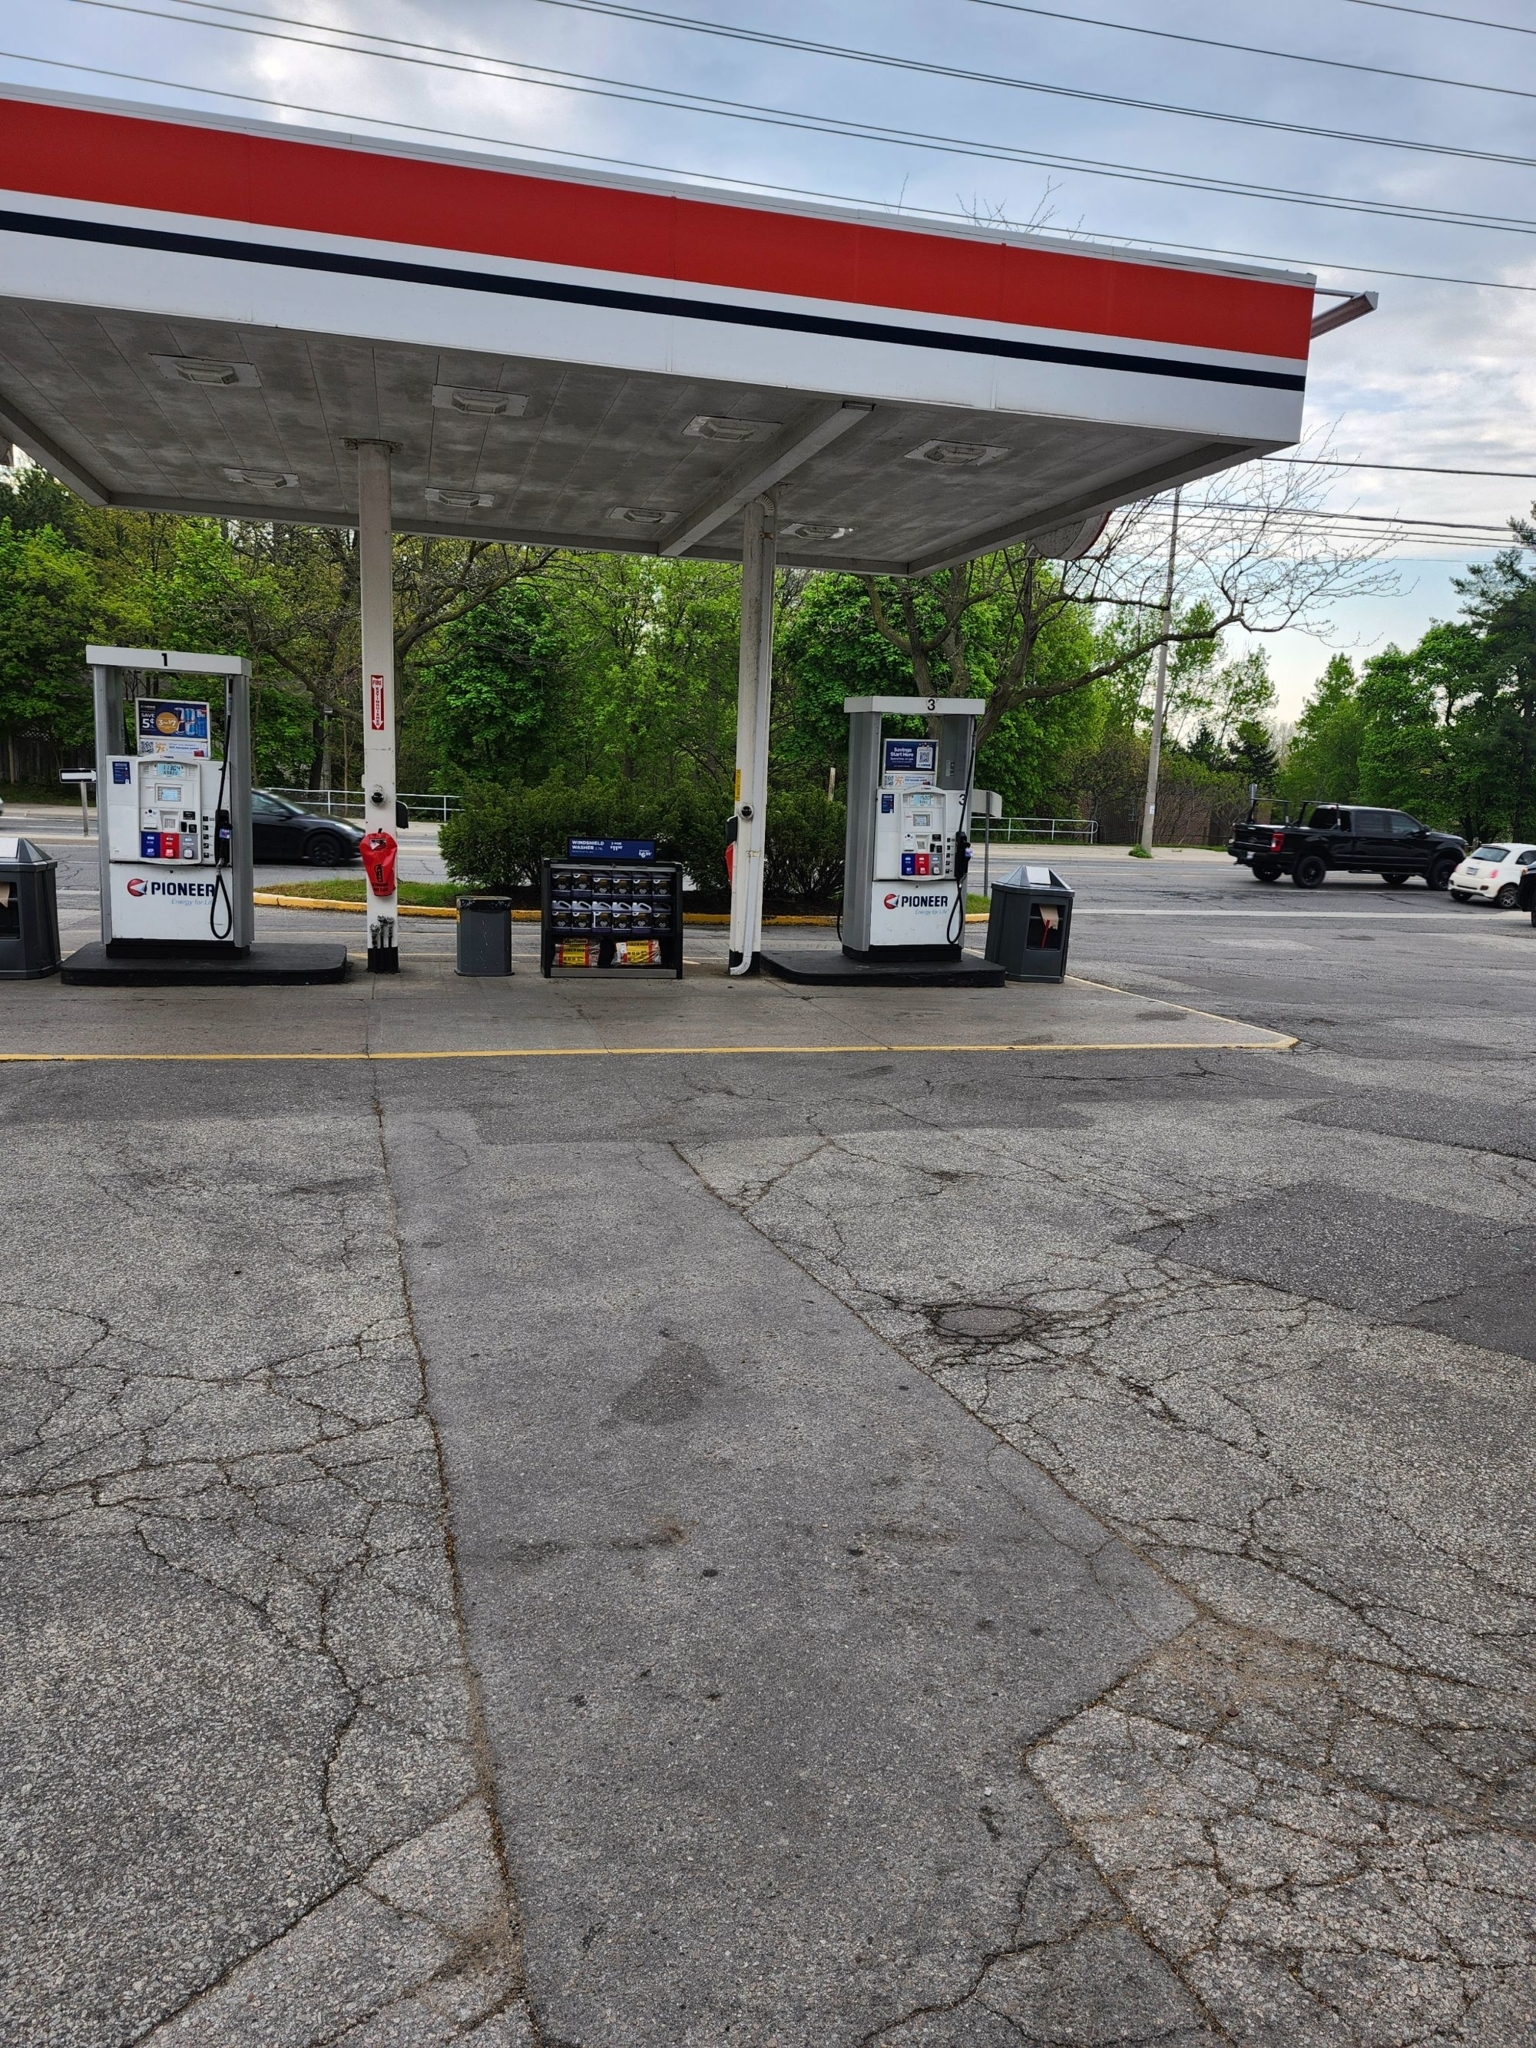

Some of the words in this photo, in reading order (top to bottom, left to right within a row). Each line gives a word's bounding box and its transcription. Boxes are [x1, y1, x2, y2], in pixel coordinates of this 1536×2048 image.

[161, 653, 168, 667] 1
[927, 699, 936, 711] 3
[959, 793, 966, 806] 3
[151, 882, 215, 897] PIONEER
[901, 895, 948, 908] PIONEER
